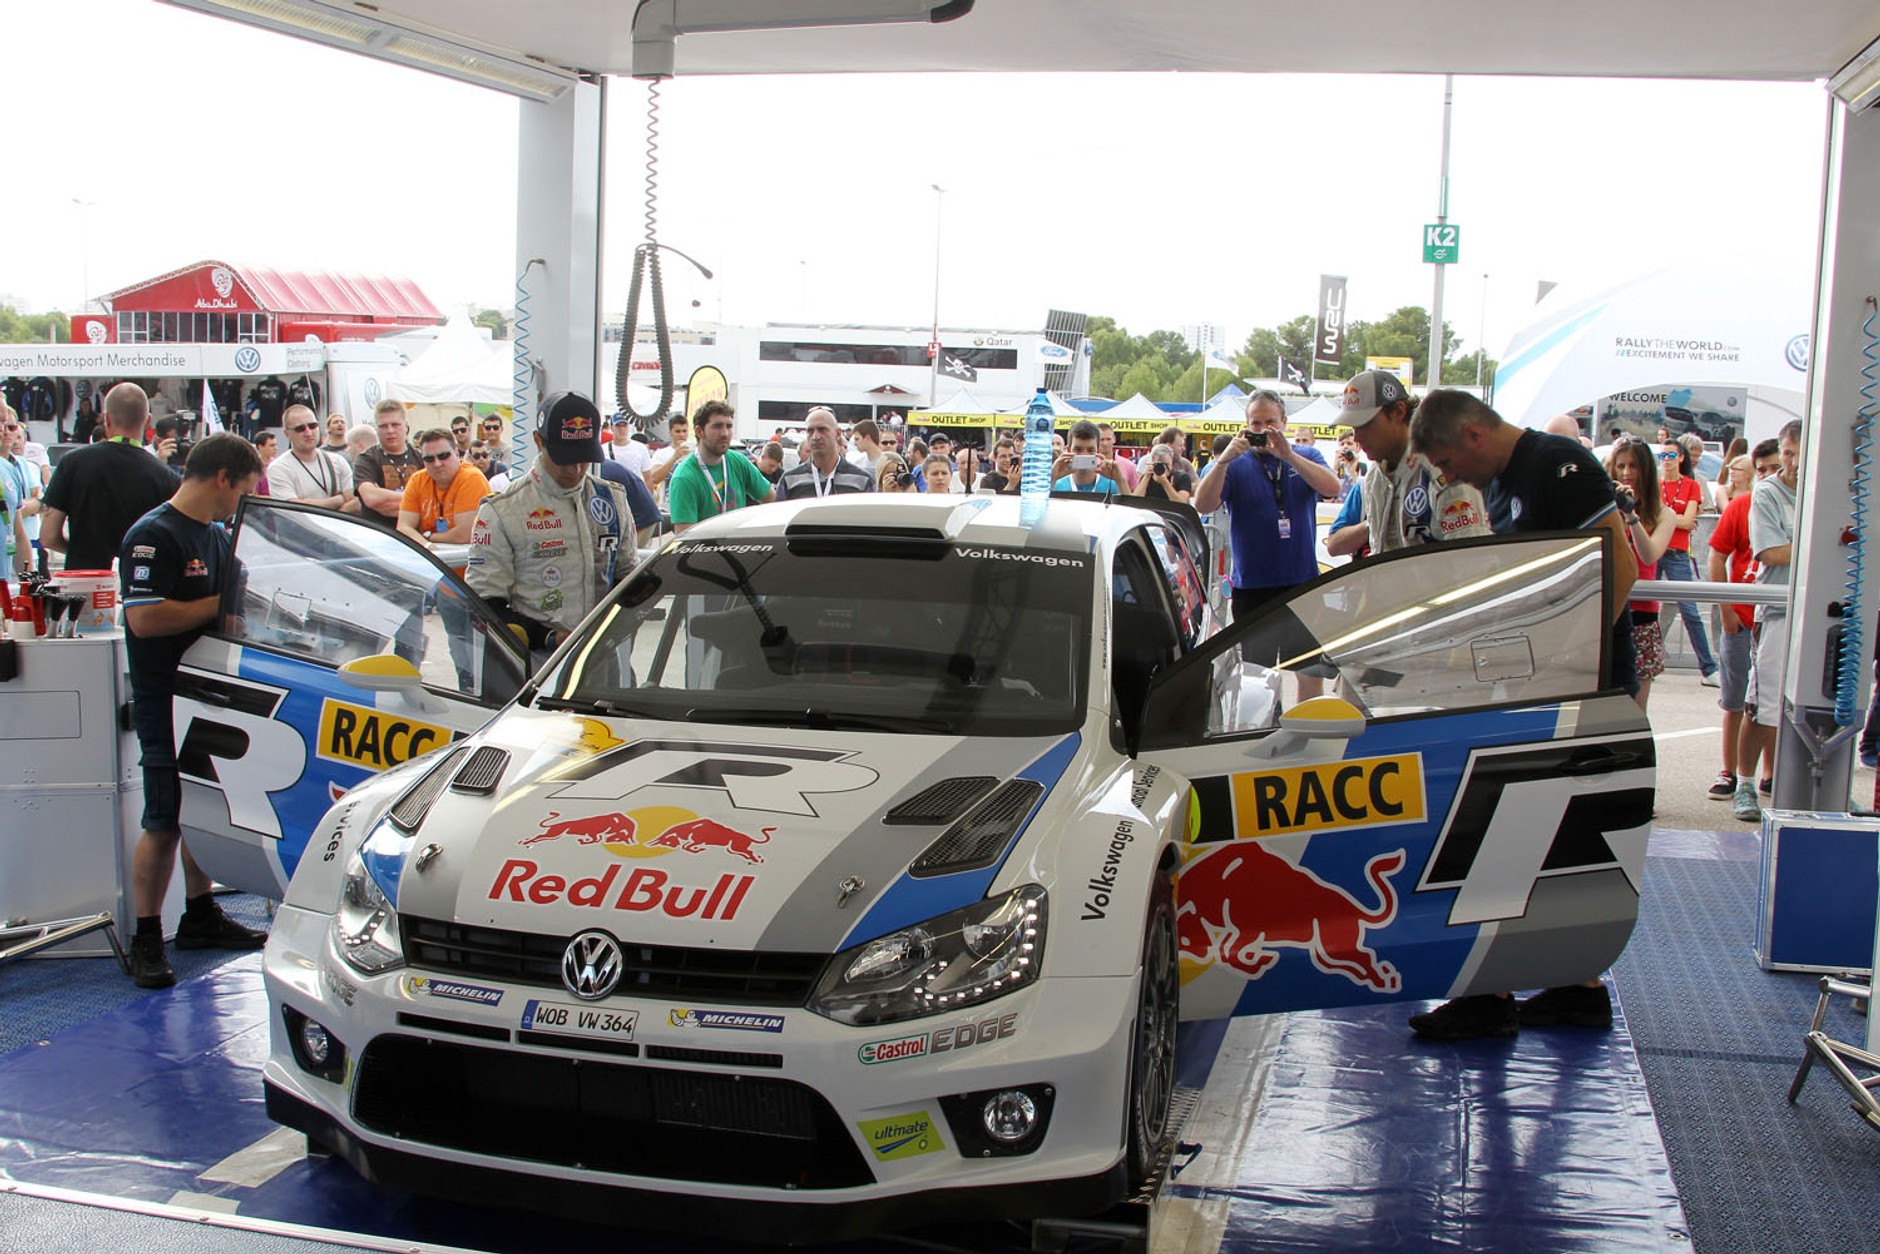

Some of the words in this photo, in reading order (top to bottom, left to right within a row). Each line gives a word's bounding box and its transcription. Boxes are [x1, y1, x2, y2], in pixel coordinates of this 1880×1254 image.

[1426, 227, 1456, 246] K2
[986, 337, 1013, 346] Qatar
[37, 354, 103, 370] Motorsport
[107, 353, 186, 367] Merchandise
[1708, 353, 1739, 361] SHARE
[1609, 392, 1668, 404] WELCOME
[932, 416, 967, 424] OUTLET
[1110, 421, 1148, 430] OUTLET
[1203, 423, 1242, 431] OUTLET
[1313, 426, 1336, 435] TLET
[527, 521, 544, 530] Red
[544, 519, 562, 529] Bull
[1441, 517, 1461, 533] Red
[671, 543, 773, 554] Volkswagen
[956, 547, 1084, 568] Volkswagen
[331, 708, 435, 767] RACC
[1254, 762, 1403, 830] RACC
[1081, 820, 1134, 921] Volkswagen
[489, 859, 622, 904] Red
[615, 868, 756, 921] Bull
[434, 983, 501, 1002] MICHELIN
[536, 1006, 568, 1026] WOB
[577, 1011, 600, 1029] VW
[600, 1014, 634, 1034] 364
[701, 1013, 783, 1029] MICHELIN
[876, 1037, 925, 1060] Castrol
[930, 1013, 1018, 1054] EDGE
[874, 1120, 929, 1141] ultimate
